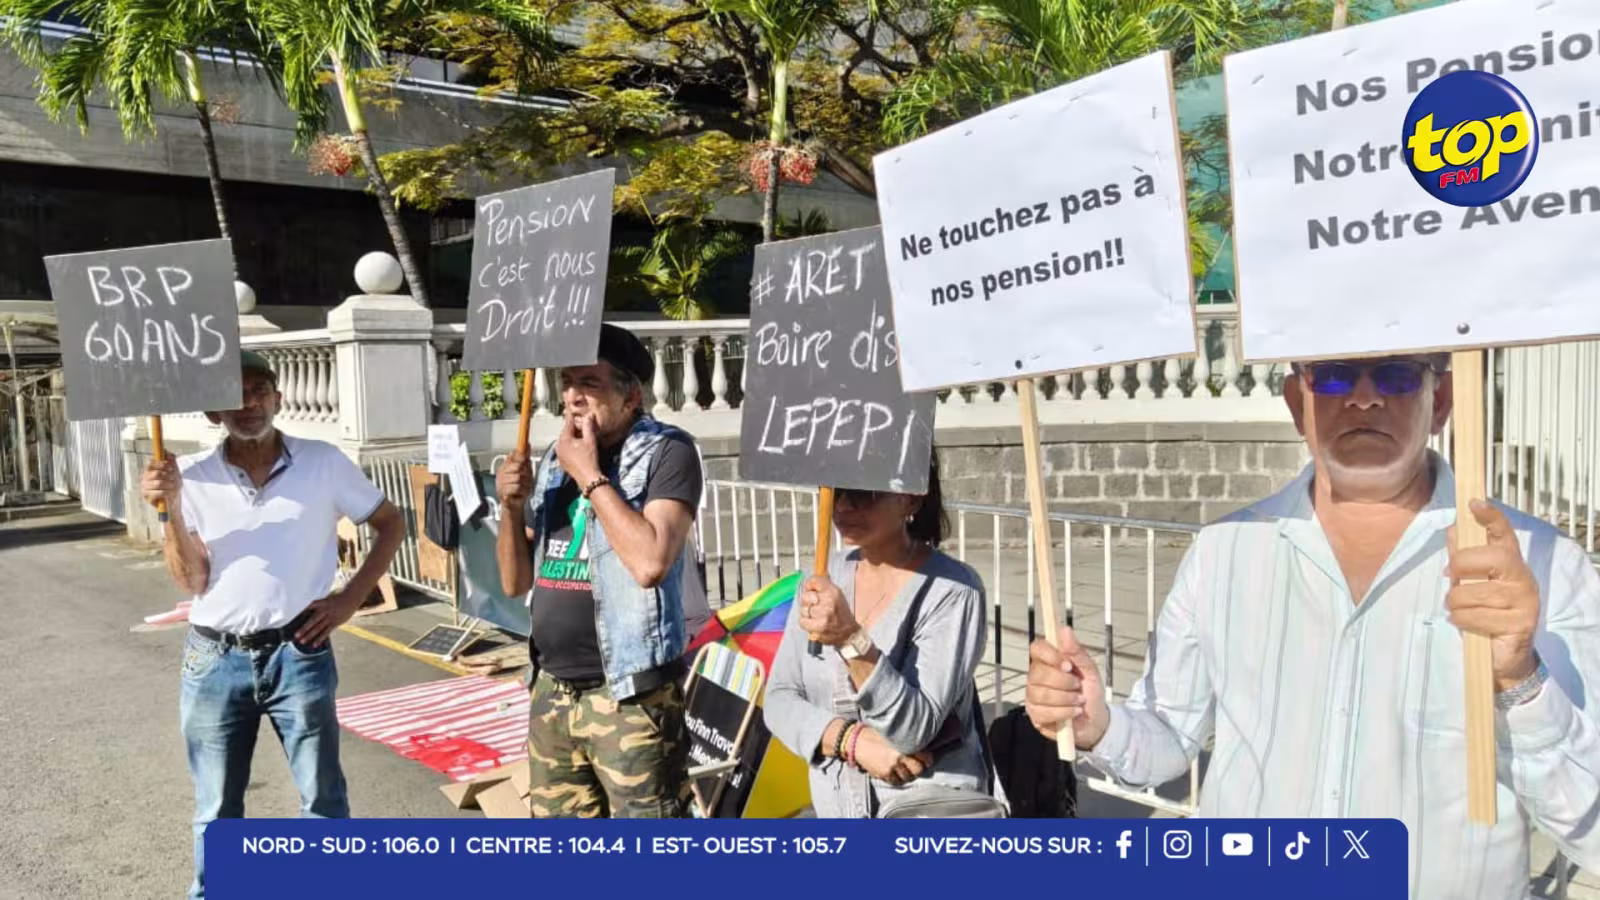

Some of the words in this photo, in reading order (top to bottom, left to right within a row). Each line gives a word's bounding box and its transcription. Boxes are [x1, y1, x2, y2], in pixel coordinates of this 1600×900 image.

[1295, 76, 1388, 116] Nos
[1406, 30, 1600, 93] Pnsio
[1293, 142, 1407, 185] Notr
[900, 235, 933, 260] Ne
[939, 202, 1051, 250] touchez
[1060, 183, 1122, 224] pas
[1132, 165, 1155, 198] à
[1307, 209, 1443, 250] Notre
[87, 266, 193, 308] BRP
[478, 256, 532, 288] c'est
[544, 251, 597, 282] nous
[930, 280, 975, 306] nos
[981, 237, 1125, 300] pension!!
[755, 321, 833, 369] Boire
